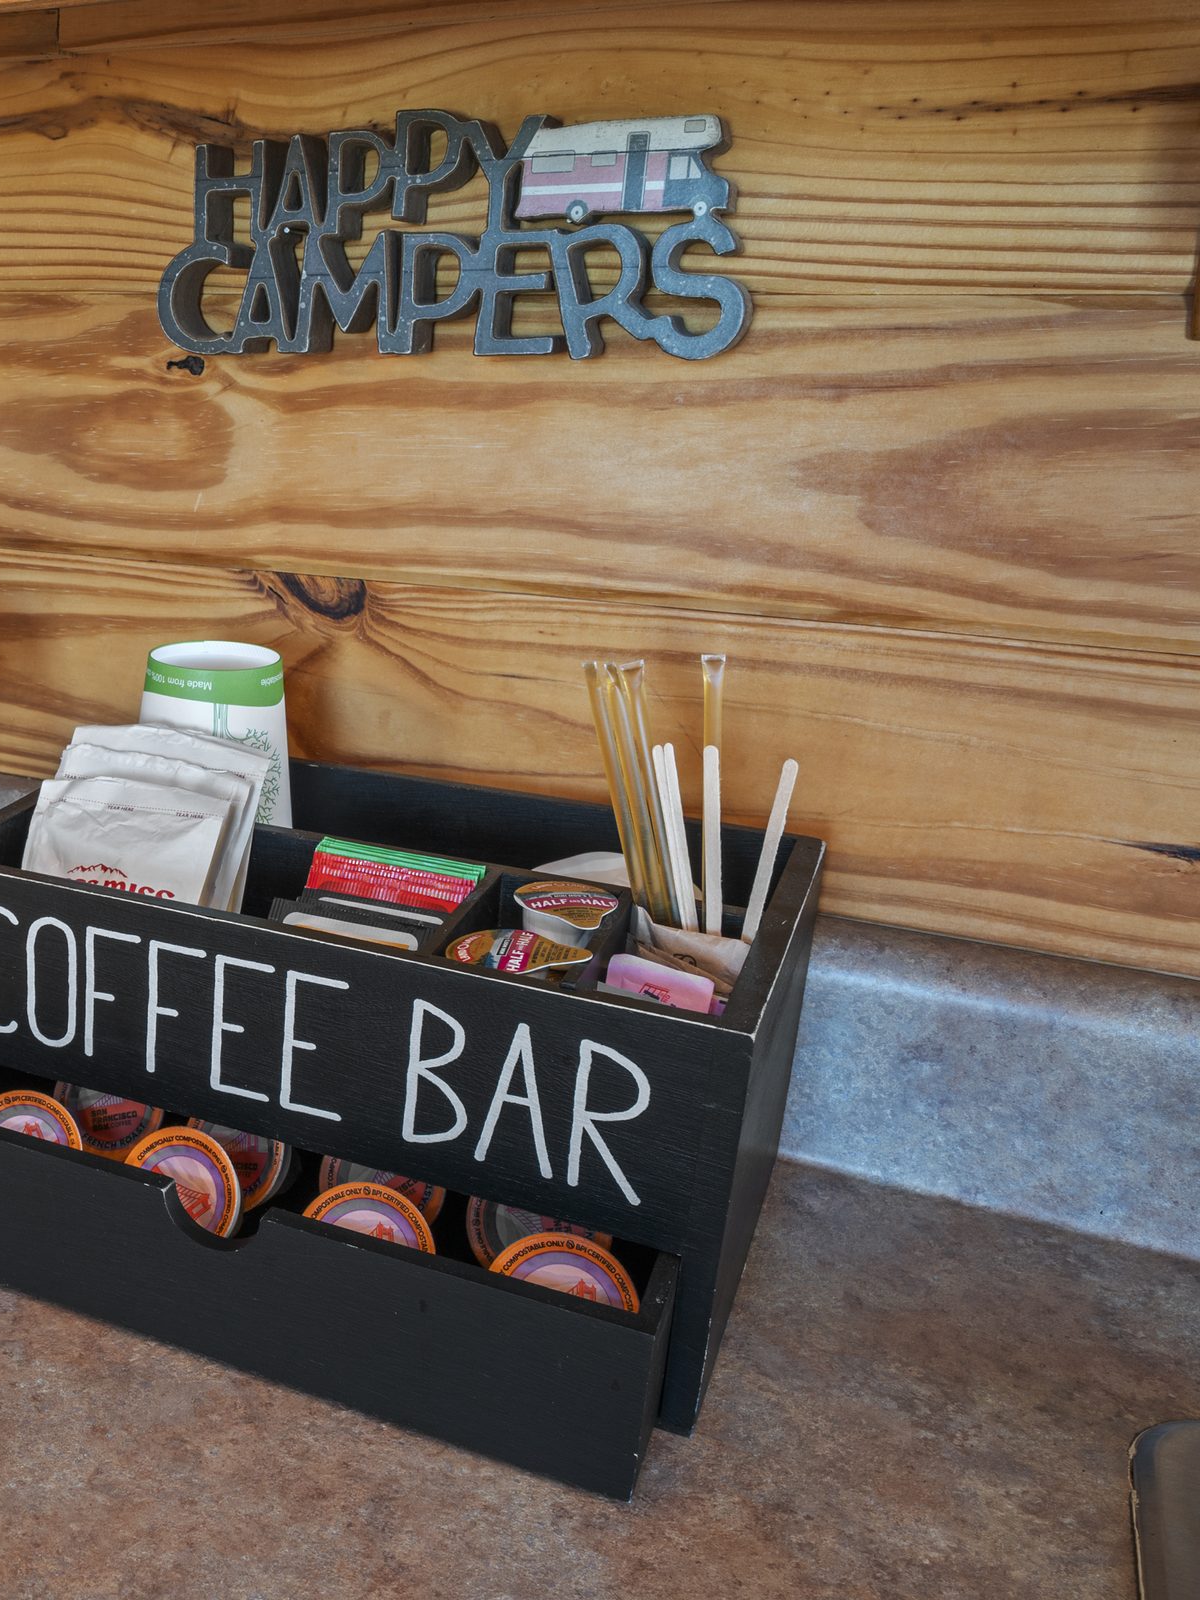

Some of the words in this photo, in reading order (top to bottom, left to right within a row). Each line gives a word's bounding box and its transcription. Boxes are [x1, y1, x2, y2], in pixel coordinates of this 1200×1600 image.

[195, 109, 548, 242] HAPPY
[157, 223, 750, 361] CAMPERS
[167, 678, 186, 688] from
[186, 680, 213, 690] Made
[531, 898, 567, 909] HALF
[506, 949, 525, 971] HALF
[516, 932, 534, 946] HALF
[21, 1095, 46, 1106] CERTIFIED
[47, 1103, 75, 1136] COMPOSTABLE
[90, 1108, 108, 1117] SAN
[91, 1110, 138, 1123] FRANCISCO
[402, 999, 650, 1205] BAR
[82, 1132, 117, 1149] FRENCH
[119, 1122, 146, 1148] ROAST
[137, 1135, 175, 1161] COMMERCIALLY
[174, 1135, 212, 1153] COMPOSTABLE
[211, 1151, 223, 1165] ONLY
[311, 1190, 346, 1219] OMPOSTABLE
[345, 1187, 363, 1196] ONLY
[371, 1189, 383, 1197] BPI
[382, 1192, 410, 1214] CERTIFIED
[502, 1241, 547, 1271] COMPOSTABLE
[546, 1240, 565, 1248] ONLY
[575, 1243, 587, 1254] BPI
[587, 1248, 618, 1274] CERTIFIED
